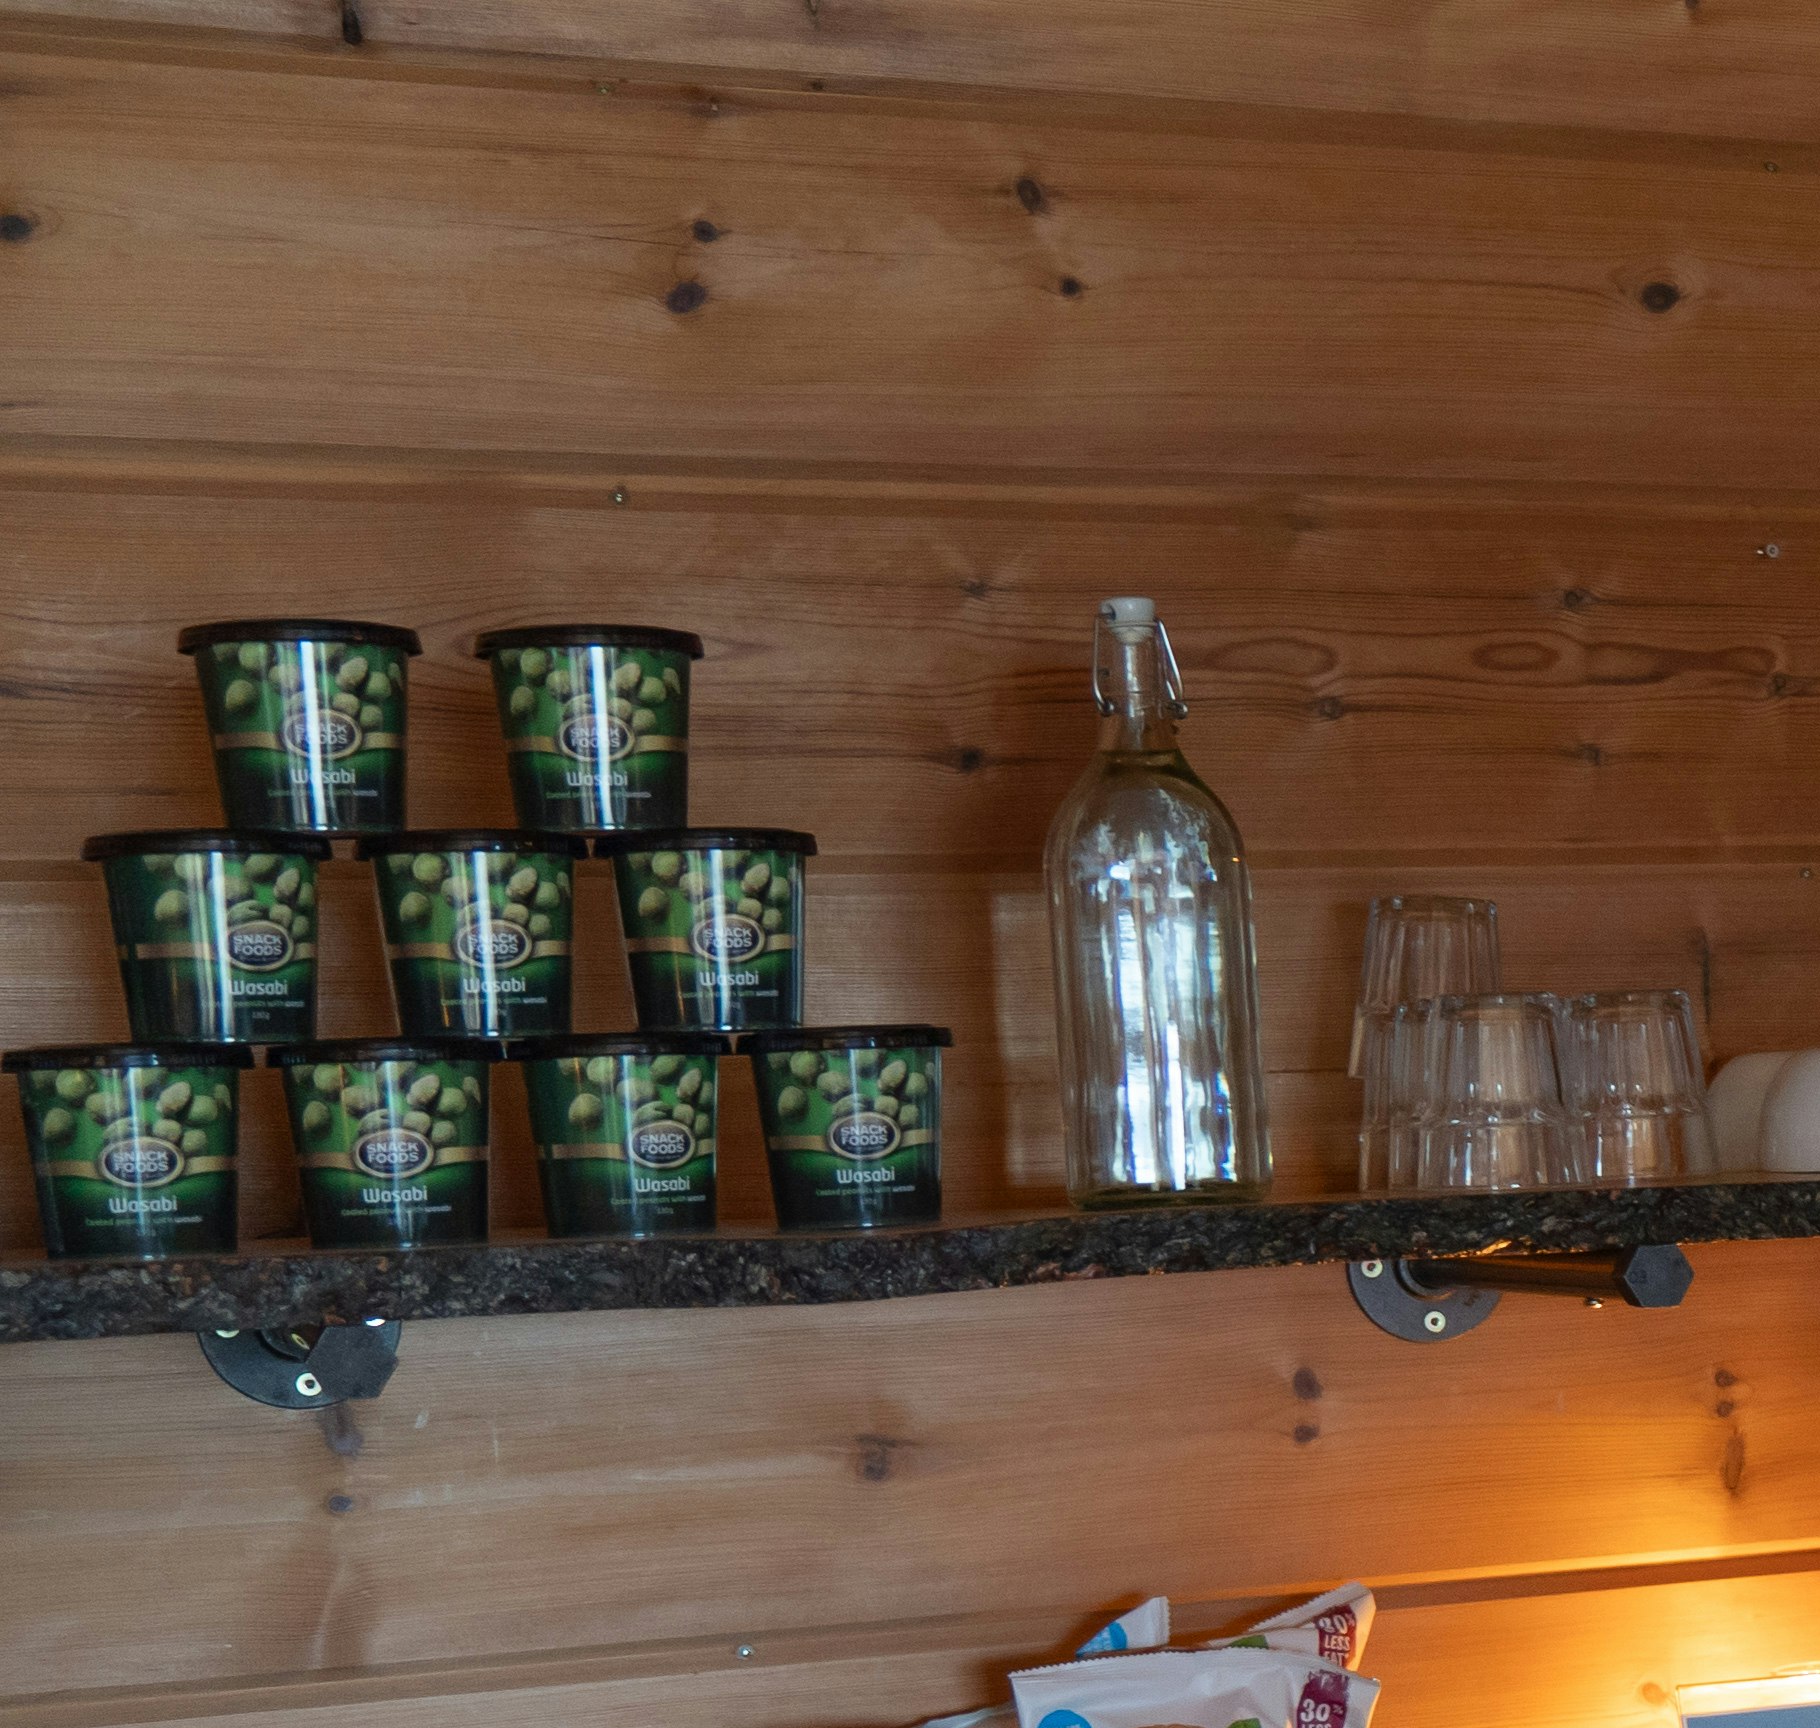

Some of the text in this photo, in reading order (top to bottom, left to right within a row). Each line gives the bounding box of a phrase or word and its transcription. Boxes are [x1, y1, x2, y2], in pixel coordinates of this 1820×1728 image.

[290, 768, 356, 784] Wsabi
[232, 934, 283, 945] SNACK
[233, 945, 283, 956] FOODS
[230, 980, 288, 995] Wasabi
[841, 1125, 888, 1135] SNACK
[640, 1133, 685, 1144] SNACK
[842, 1135, 888, 1145] FOODS
[366, 1142, 419, 1153] SNACK
[641, 1144, 685, 1154] FOODS
[367, 1152, 419, 1163] FOODS
[836, 1166, 895, 1184] Wasabi
[635, 1176, 690, 1192] Wasabi
[363, 1185, 428, 1203] Wasabi
[108, 1195, 178, 1213] Wasabi
